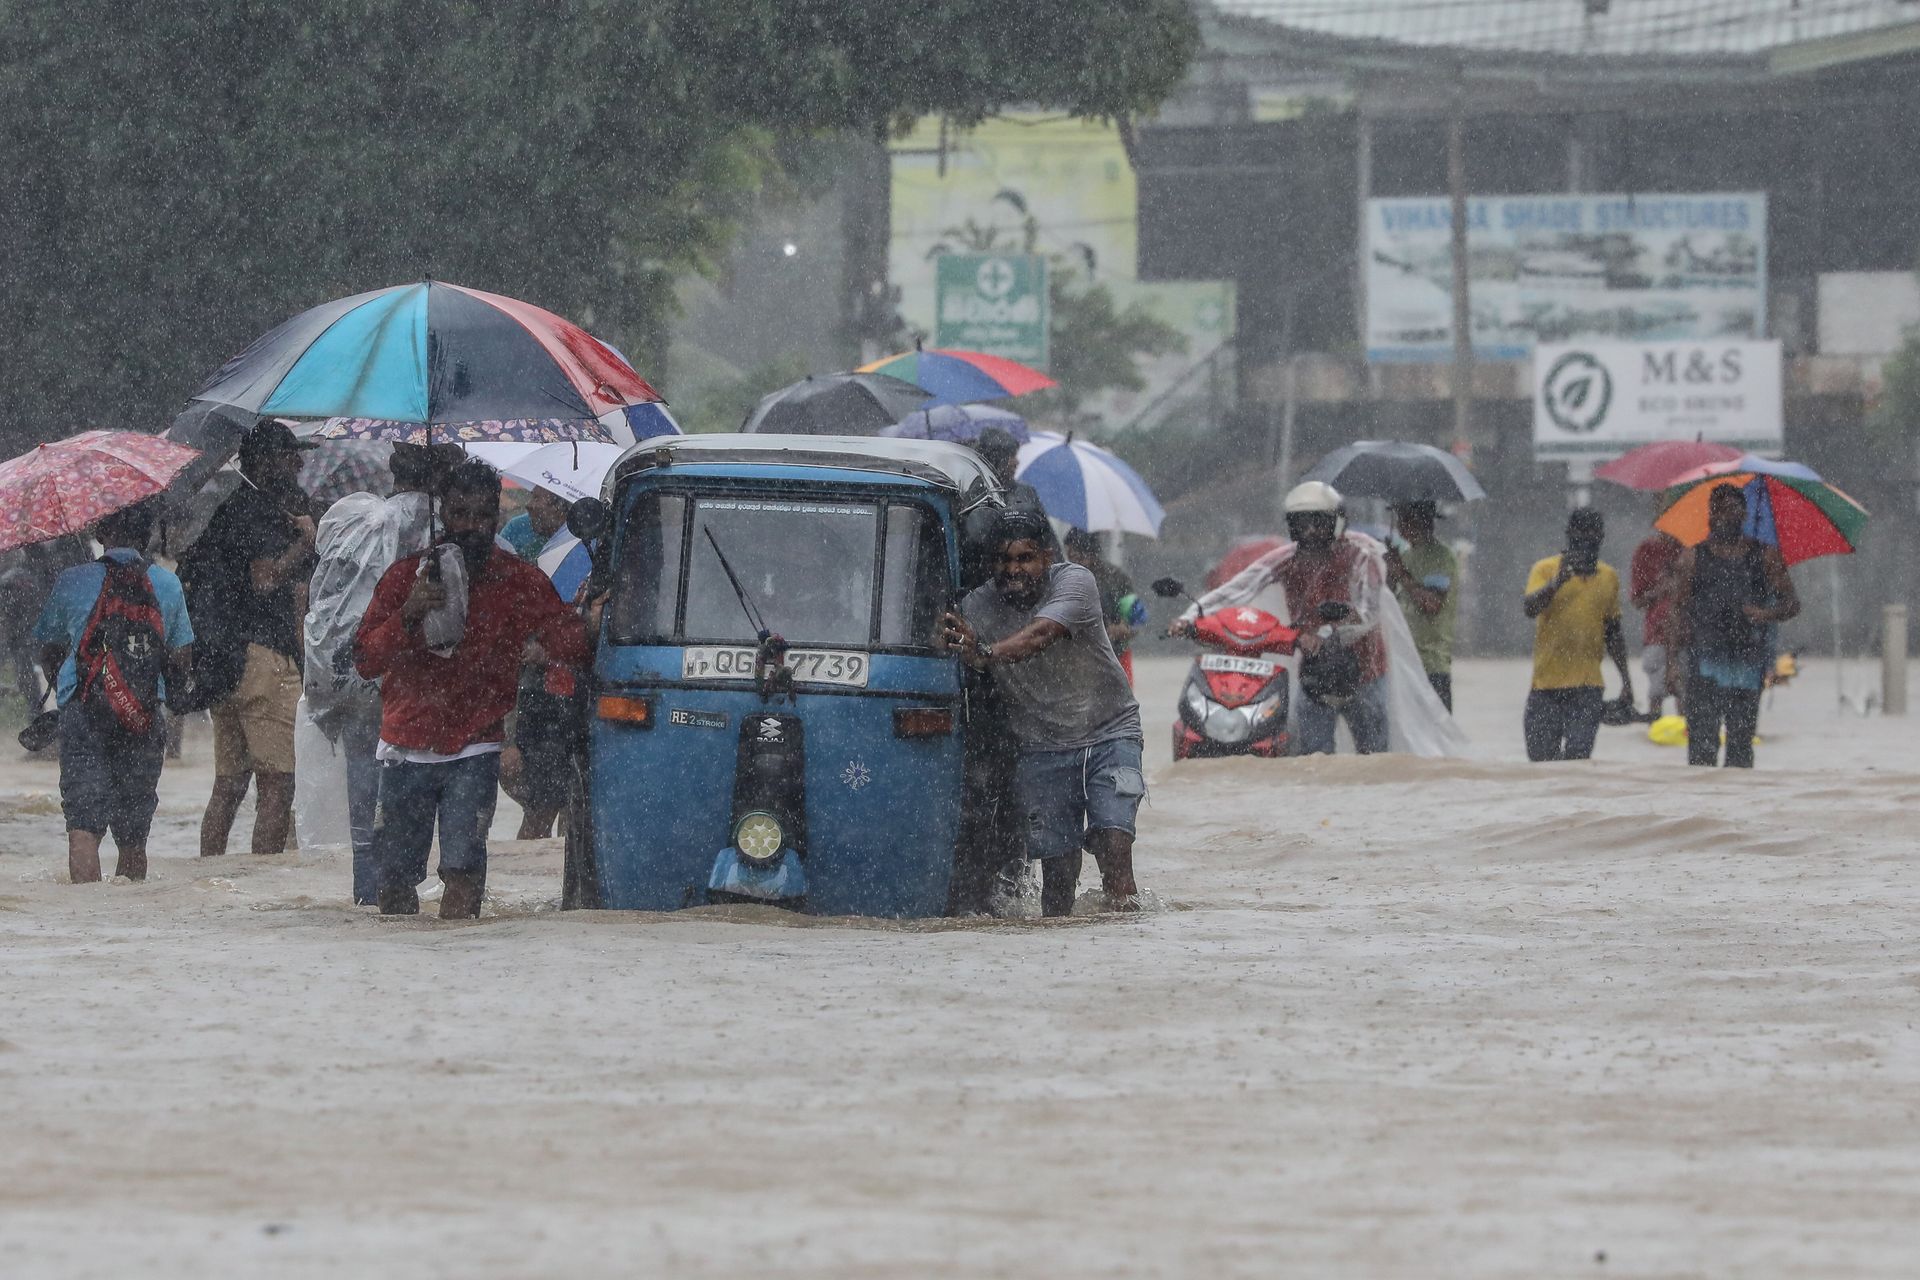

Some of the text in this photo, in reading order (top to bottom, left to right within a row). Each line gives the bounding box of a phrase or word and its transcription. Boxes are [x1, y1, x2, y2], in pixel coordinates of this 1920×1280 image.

[1502, 201, 1582, 230] SHADE
[1595, 200, 1750, 231] STRUCTURES
[1641, 348, 1742, 385] M&S
[715, 650, 754, 674] QG
[788, 653, 863, 681] 7739
[671, 711, 725, 729] RE 2 STROKE
